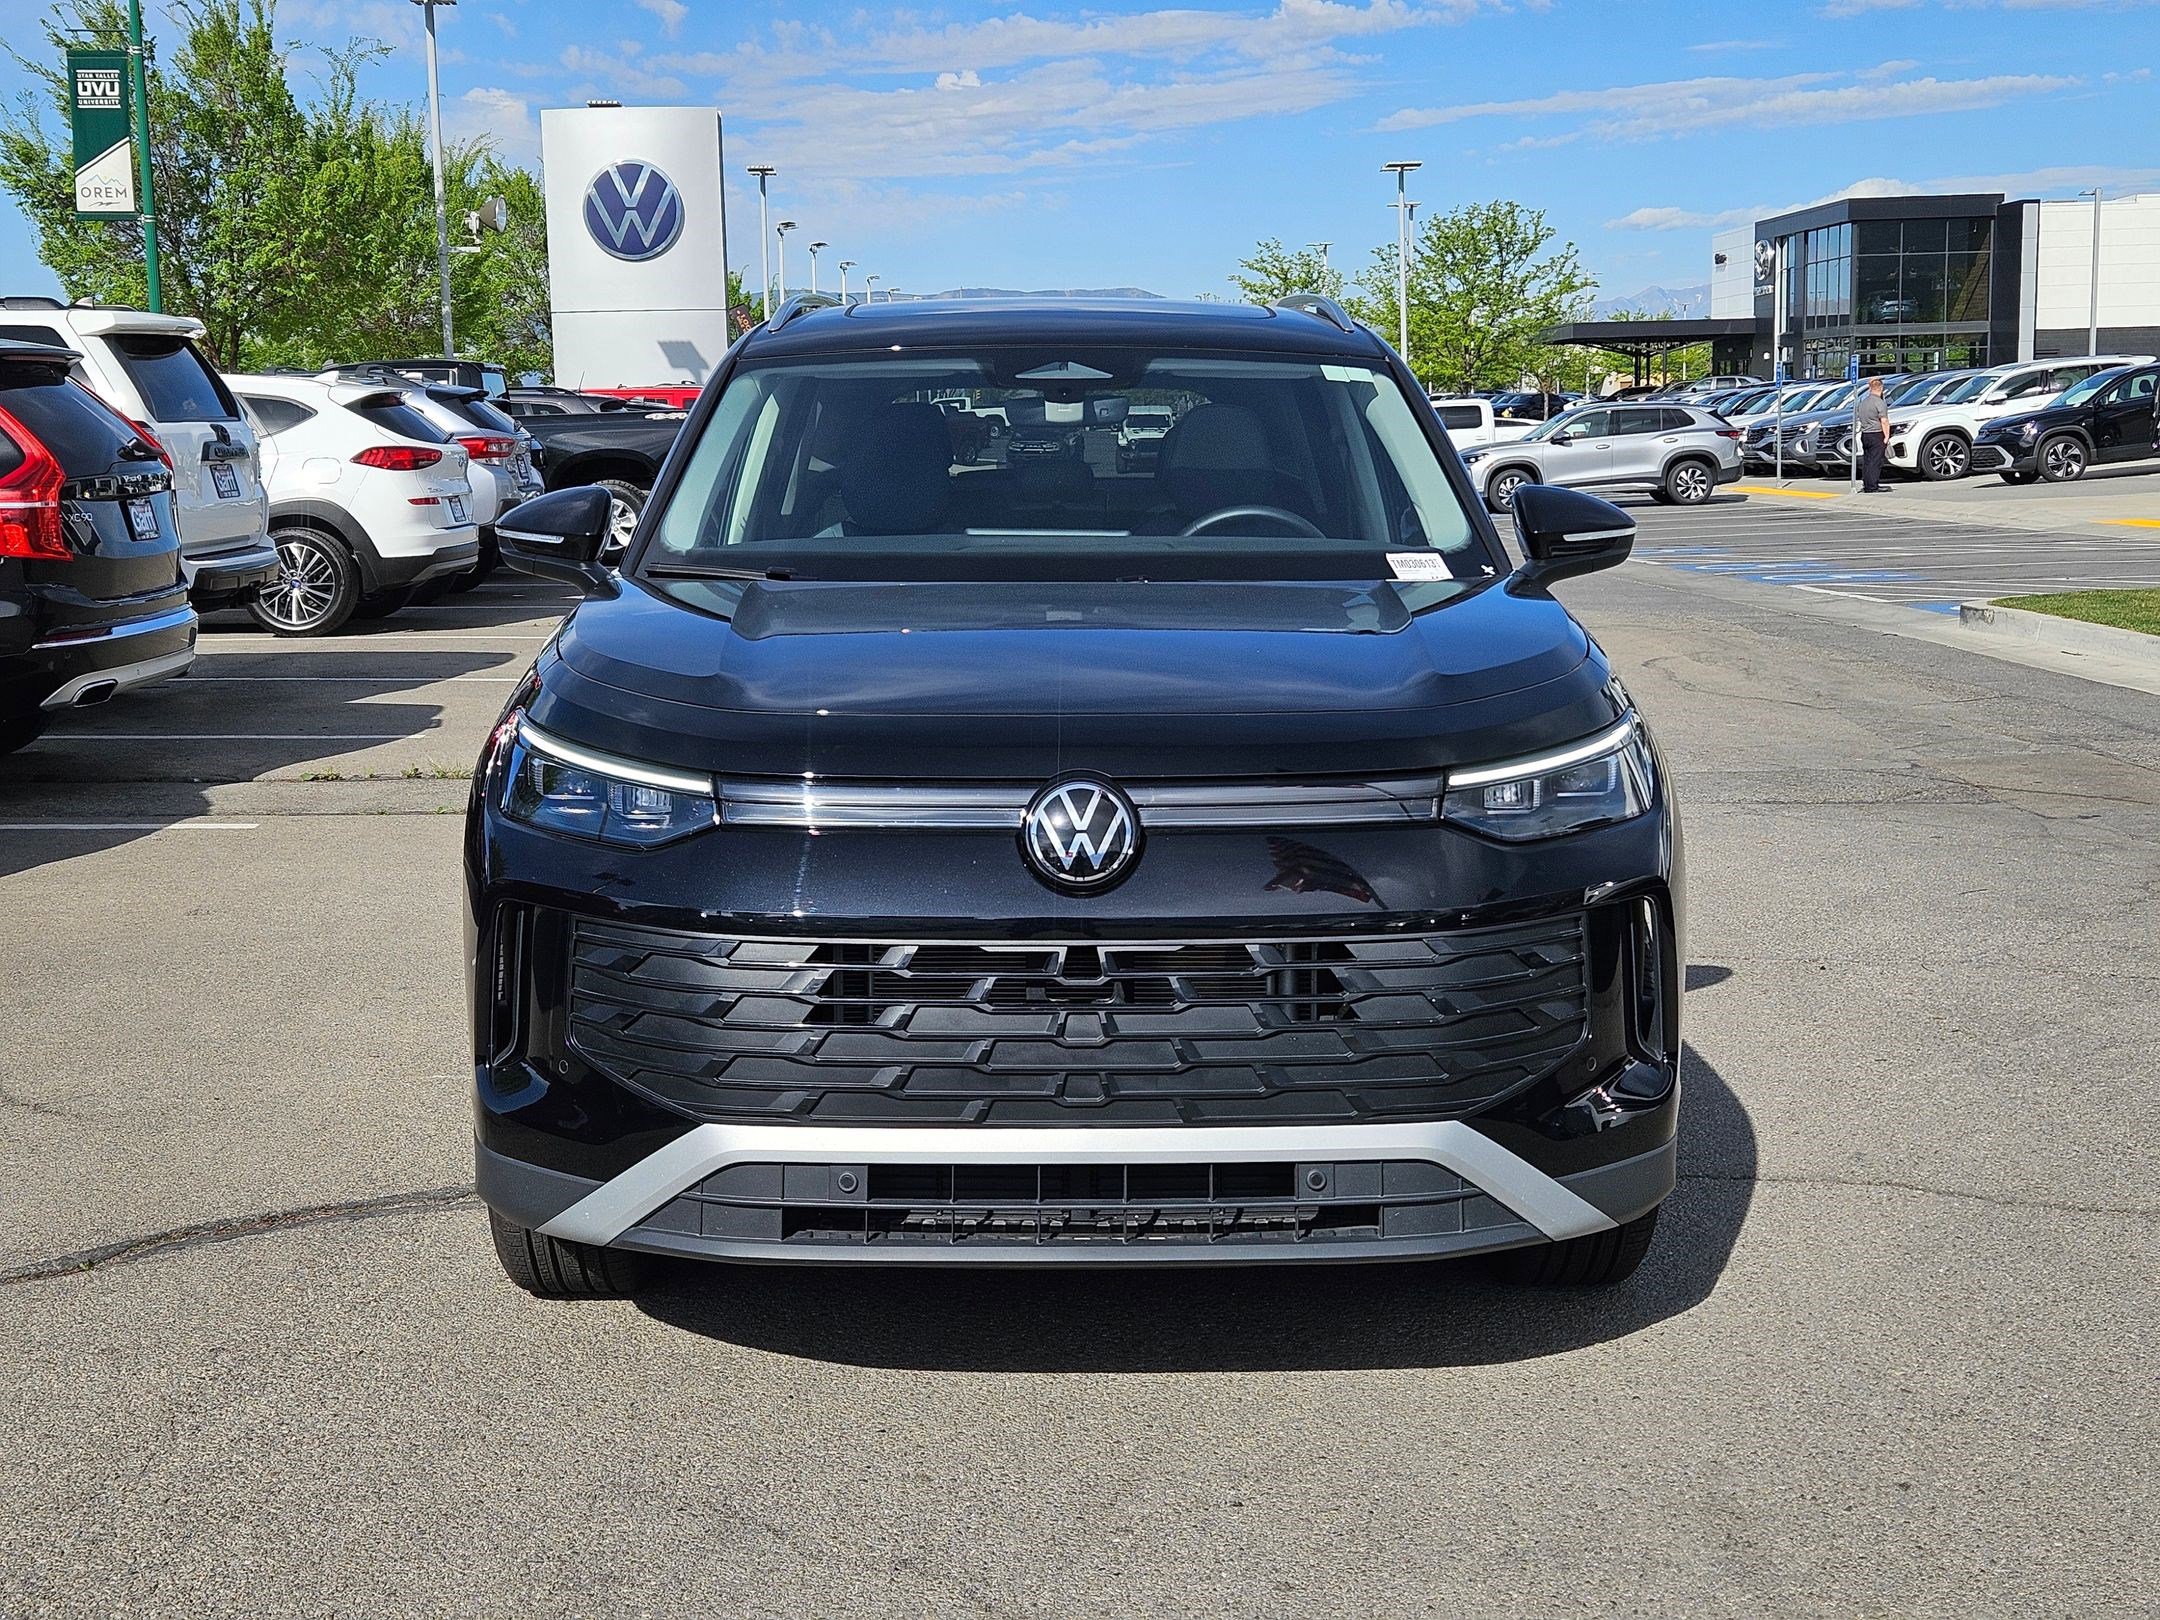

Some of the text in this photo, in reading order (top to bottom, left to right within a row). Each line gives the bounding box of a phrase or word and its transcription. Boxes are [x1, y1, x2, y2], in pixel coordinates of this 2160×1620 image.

[77, 81, 119, 96] UVU
[81, 186, 127, 198] OREM
[68, 512, 93, 522] XC90
